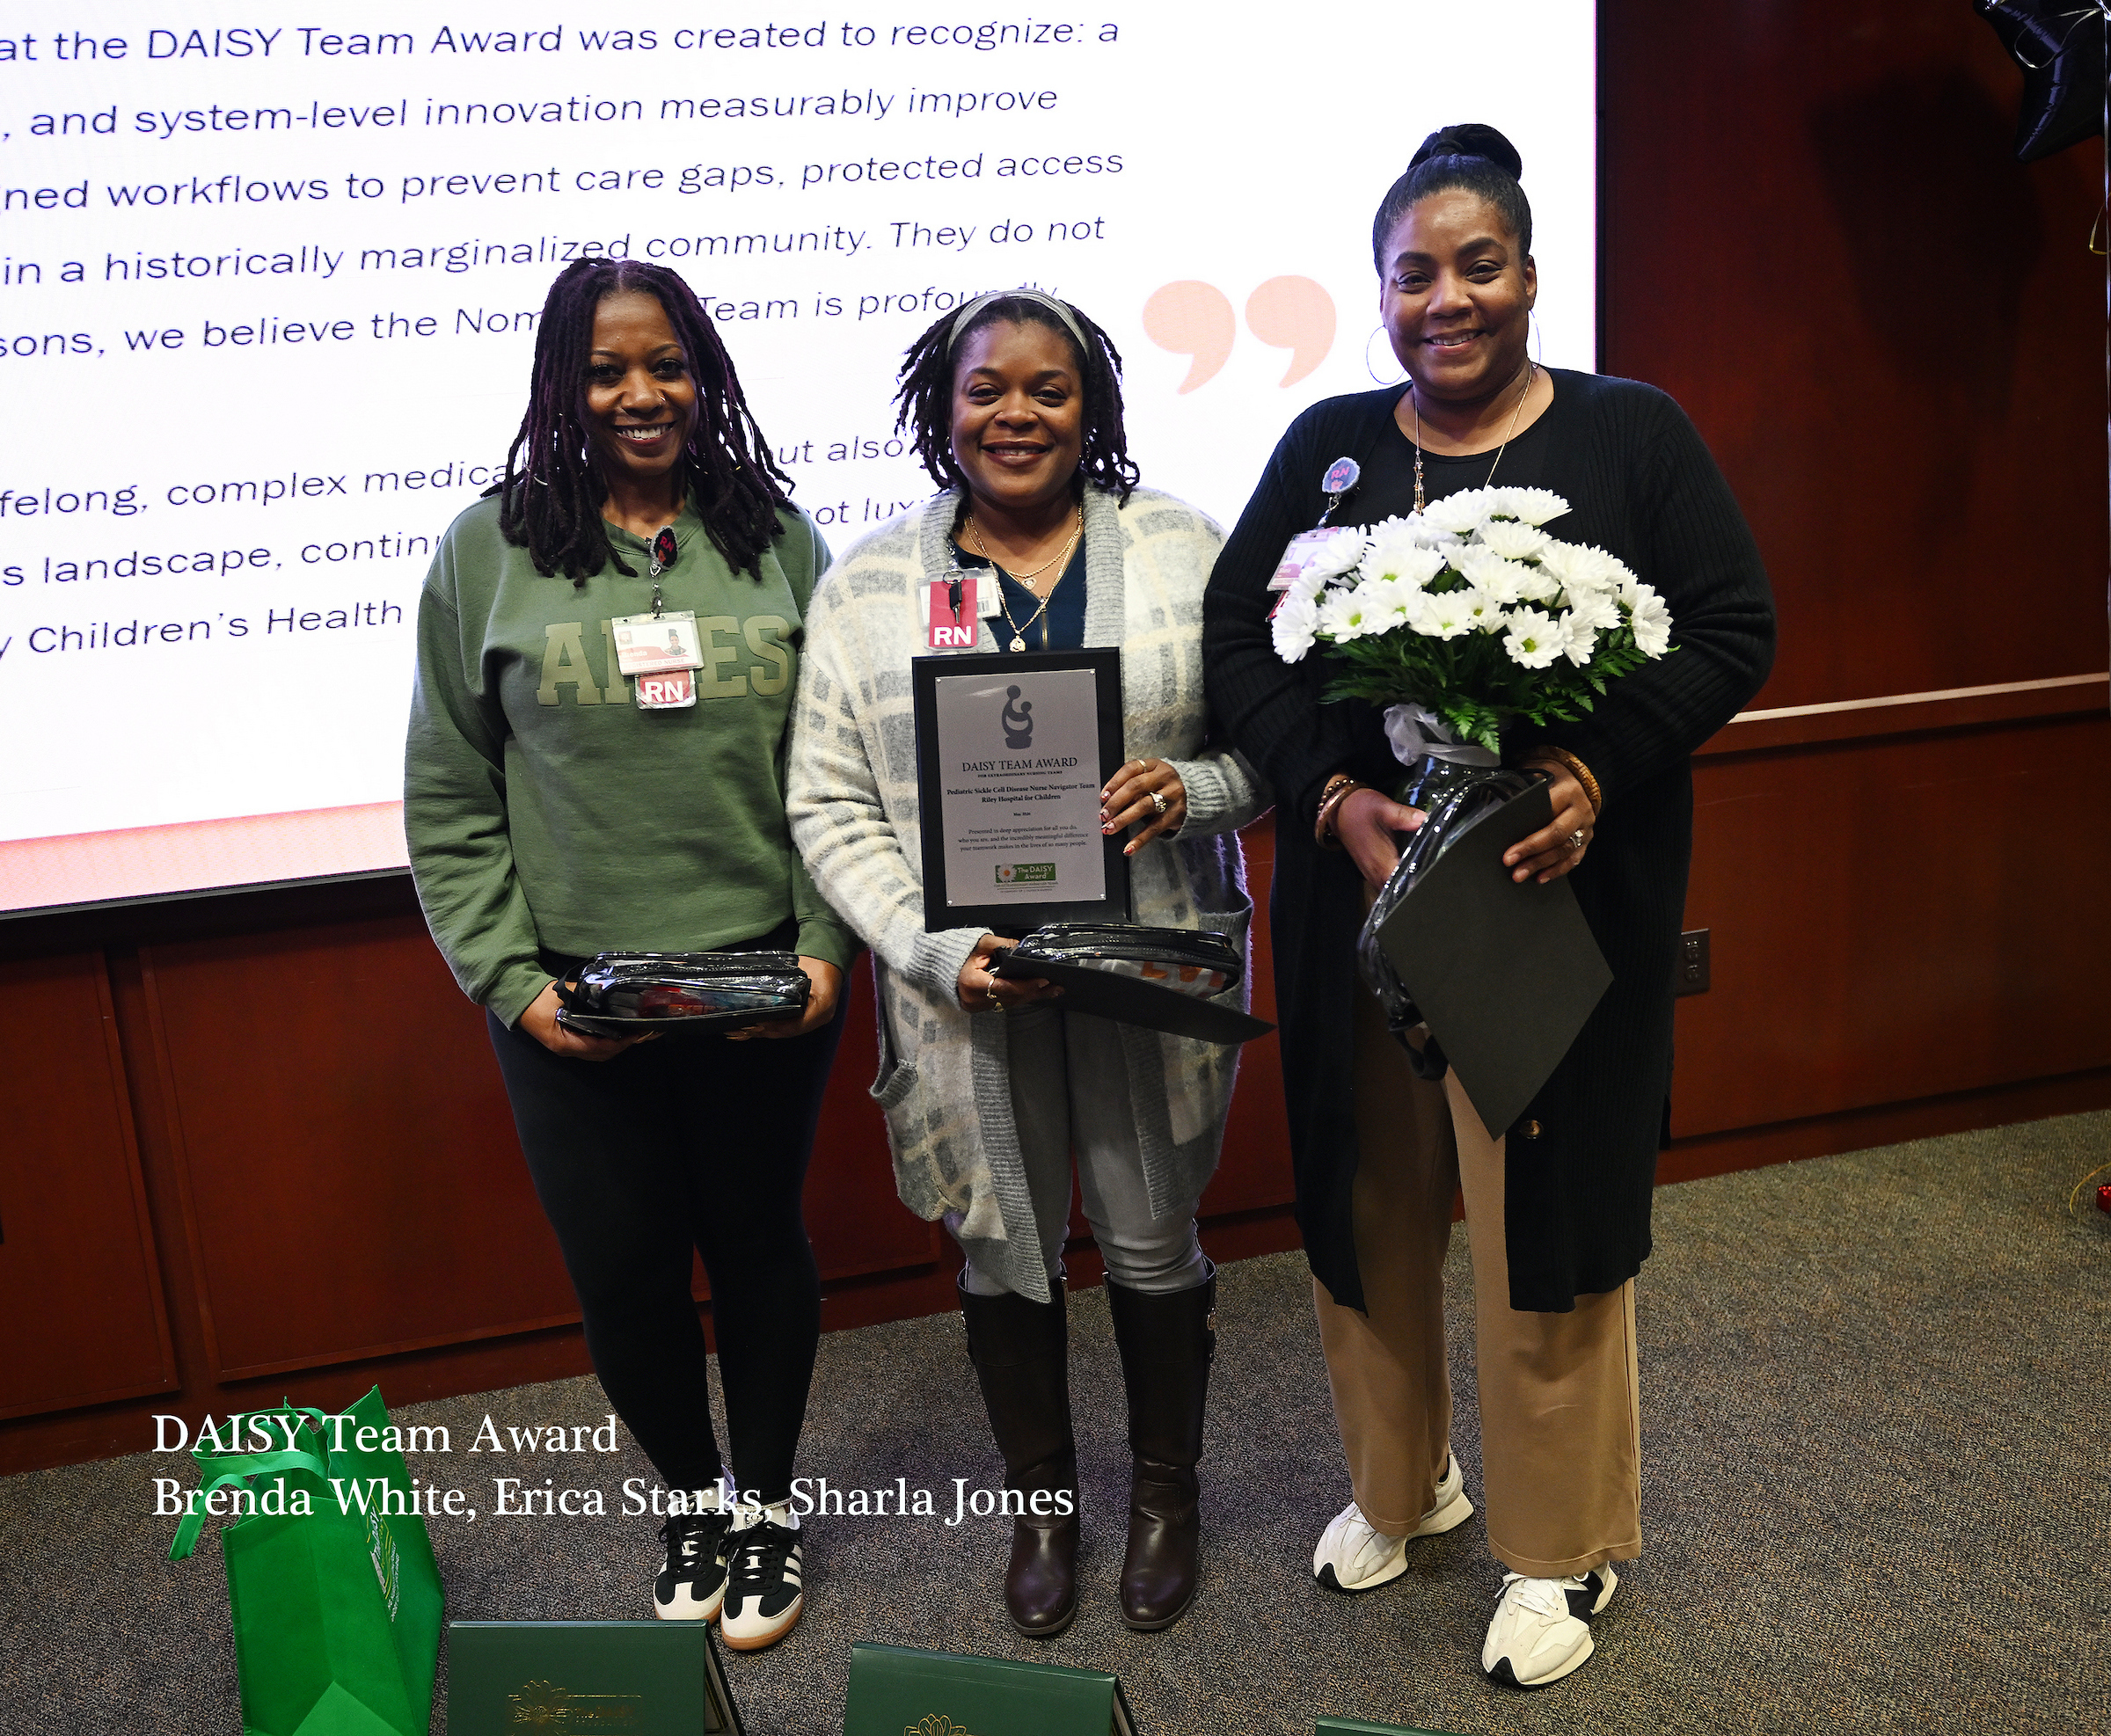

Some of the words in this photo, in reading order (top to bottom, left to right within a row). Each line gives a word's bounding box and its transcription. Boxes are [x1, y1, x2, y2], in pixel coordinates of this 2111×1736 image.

[54, 31, 128, 60] the
[149, 28, 281, 59] DAISY
[296, 28, 413, 55] Team
[431, 25, 562, 54] Award
[580, 30, 657, 51] was
[675, 21, 826, 49] created
[842, 22, 875, 46] to
[892, 18, 1084, 50] recognize:
[1099, 24, 1118, 41] a
[31, 106, 117, 135] and
[135, 99, 406, 139] system-level
[426, 95, 641, 125] innovation
[661, 89, 895, 120] measurably
[909, 88, 1057, 118] improve
[107, 175, 329, 207] workflows
[346, 173, 384, 199] to
[402, 167, 559, 204] prevent
[576, 170, 664, 191] care
[679, 164, 784, 193] gaps,
[802, 153, 982, 190] protected
[997, 156, 1122, 176] access
[4, 257, 40, 285] in
[61, 262, 84, 282] a
[106, 245, 343, 281] historically
[361, 233, 630, 273] marginalized
[646, 225, 871, 258] community.
[890, 222, 976, 252] They
[990, 219, 1033, 243] do
[1048, 216, 1105, 241] not
[125, 329, 184, 350] we
[203, 317, 354, 346] believe
[371, 312, 437, 339] the
[456, 308, 542, 334] Nom
[698, 295, 798, 321] Team
[816, 292, 842, 317] is
[858, 282, 1057, 320] profo
[167, 472, 347, 506] complex
[365, 462, 506, 492] medica
[779, 441, 814, 464] ut
[828, 436, 903, 461] also
[45, 548, 281, 583] landscape,
[301, 532, 440, 563] contin
[805, 501, 849, 525] ot
[29, 613, 248, 653] Children's
[268, 600, 401, 634] Health
[934, 625, 971, 646] RN
[537, 616, 790, 706] AES
[645, 681, 684, 703] RN
[962, 761, 996, 772] DAISY
[998, 759, 1032, 770] TEAM
[1035, 757, 1077, 769] AWARD
